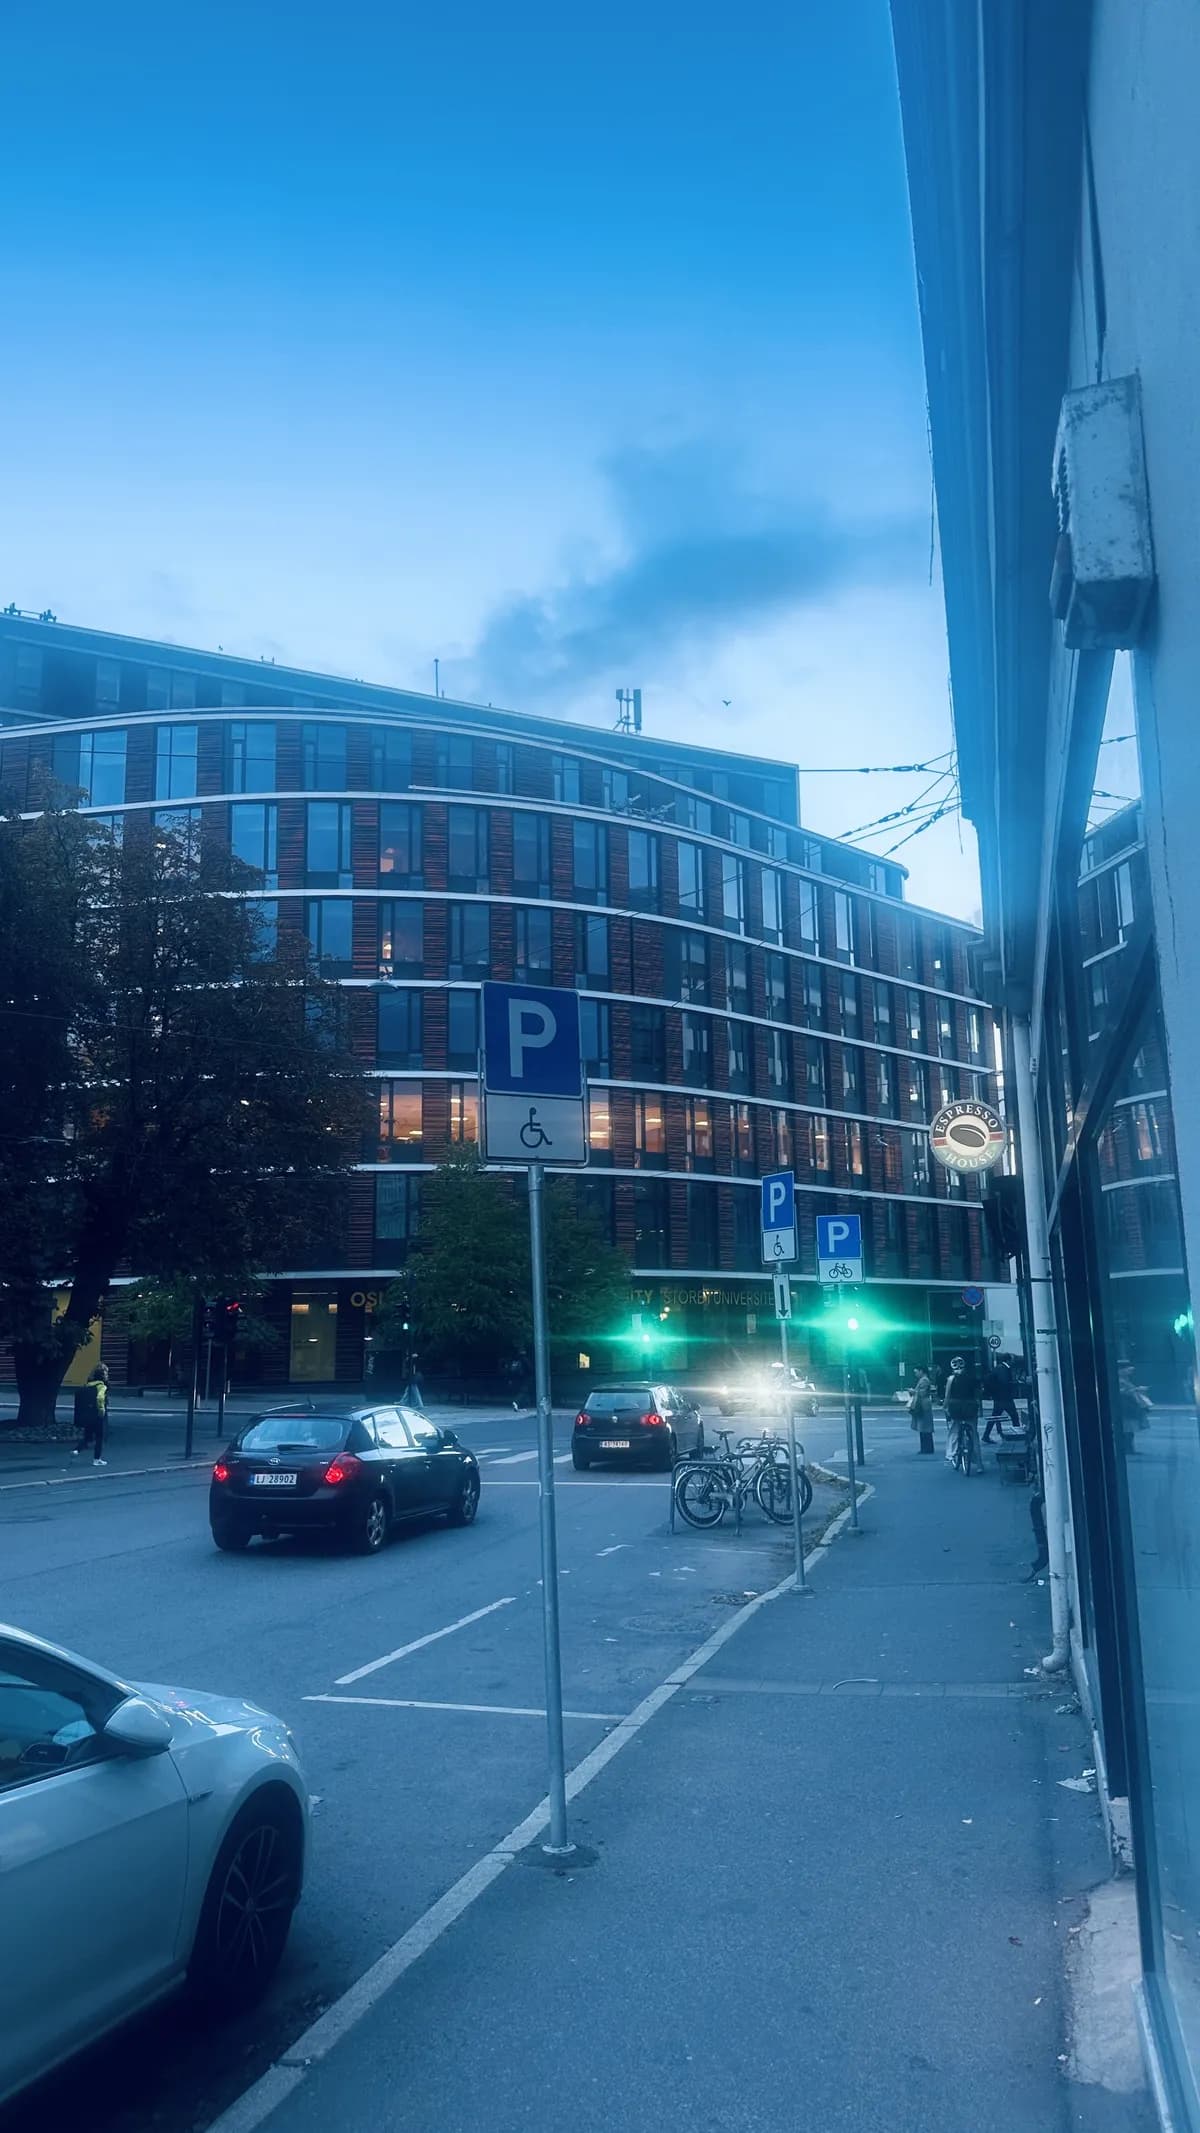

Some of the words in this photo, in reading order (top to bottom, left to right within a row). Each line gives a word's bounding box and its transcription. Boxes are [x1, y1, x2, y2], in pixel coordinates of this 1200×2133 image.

[508, 998, 557, 1079] P
[935, 1104, 999, 1133] ESPRESSO
[945, 1150, 995, 1168] HOUSE
[769, 1181, 786, 1223] P
[827, 1221, 850, 1253] P
[268, 1475, 294, 1483] 28902
